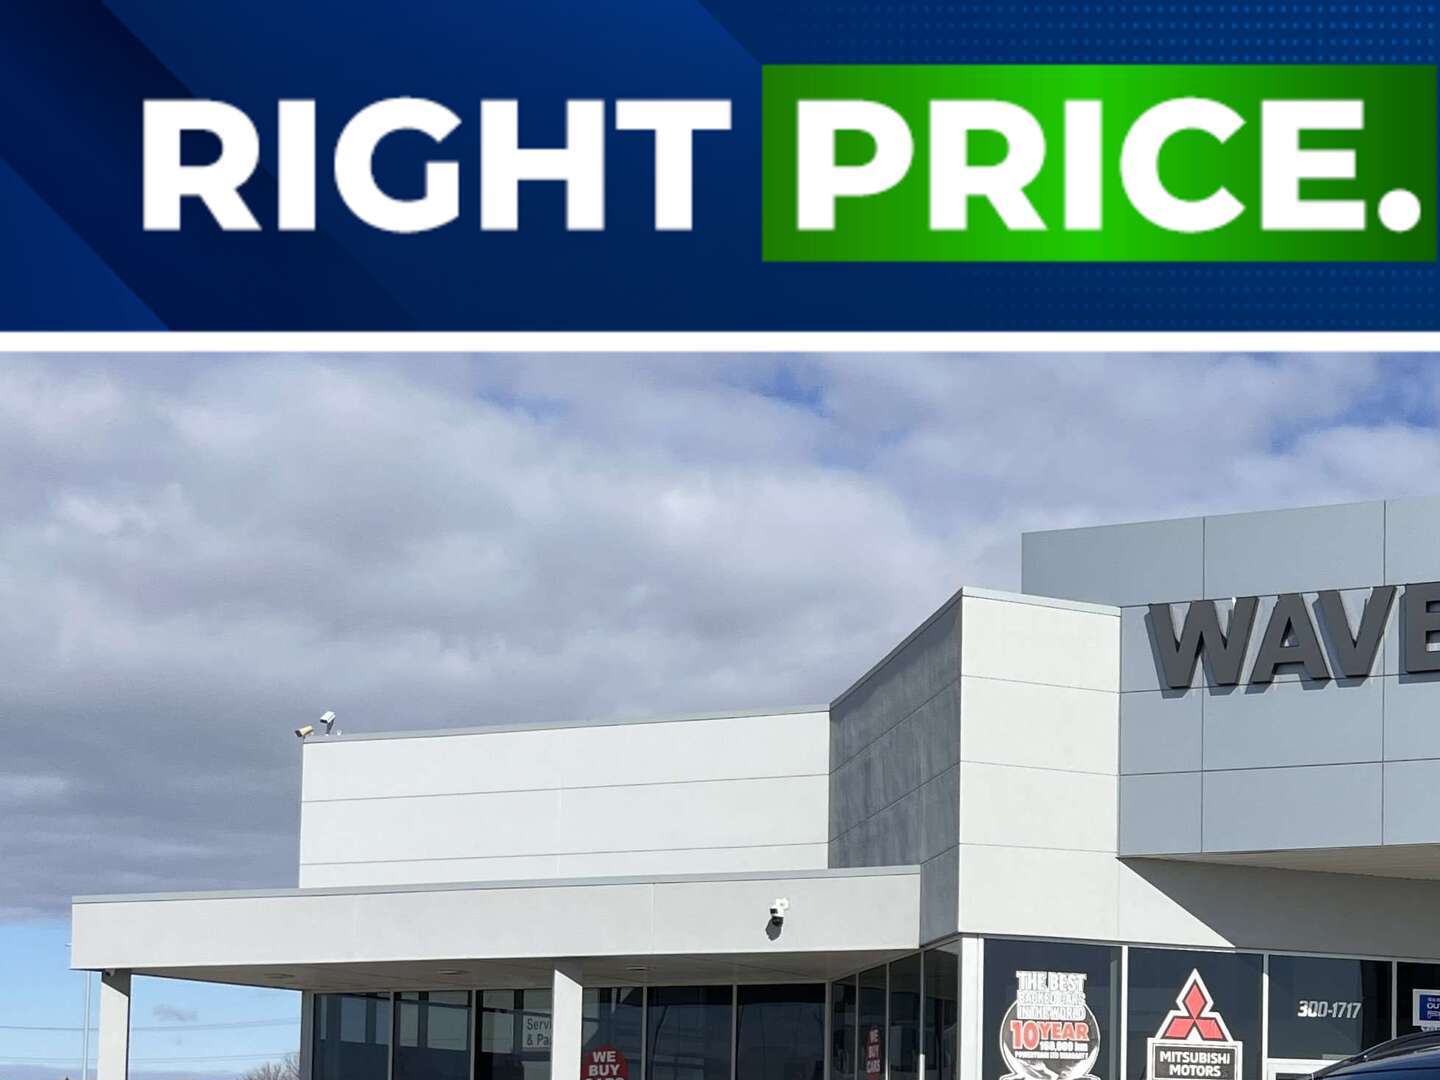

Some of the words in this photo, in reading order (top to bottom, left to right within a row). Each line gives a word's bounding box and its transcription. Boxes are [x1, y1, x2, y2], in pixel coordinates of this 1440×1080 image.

[1016, 971, 1047, 990] THE
[1048, 972, 1087, 992] BEST
[1298, 1000, 1361, 1018] 300-1717
[1010, 1020, 1040, 1050] 10
[1037, 1021, 1089, 1041] YEAR
[592, 1051, 617, 1063] WE
[1160, 1051, 1230, 1064] MITSUBISHI
[588, 1064, 620, 1076] BUY
[1169, 1064, 1221, 1077] MOTORS
